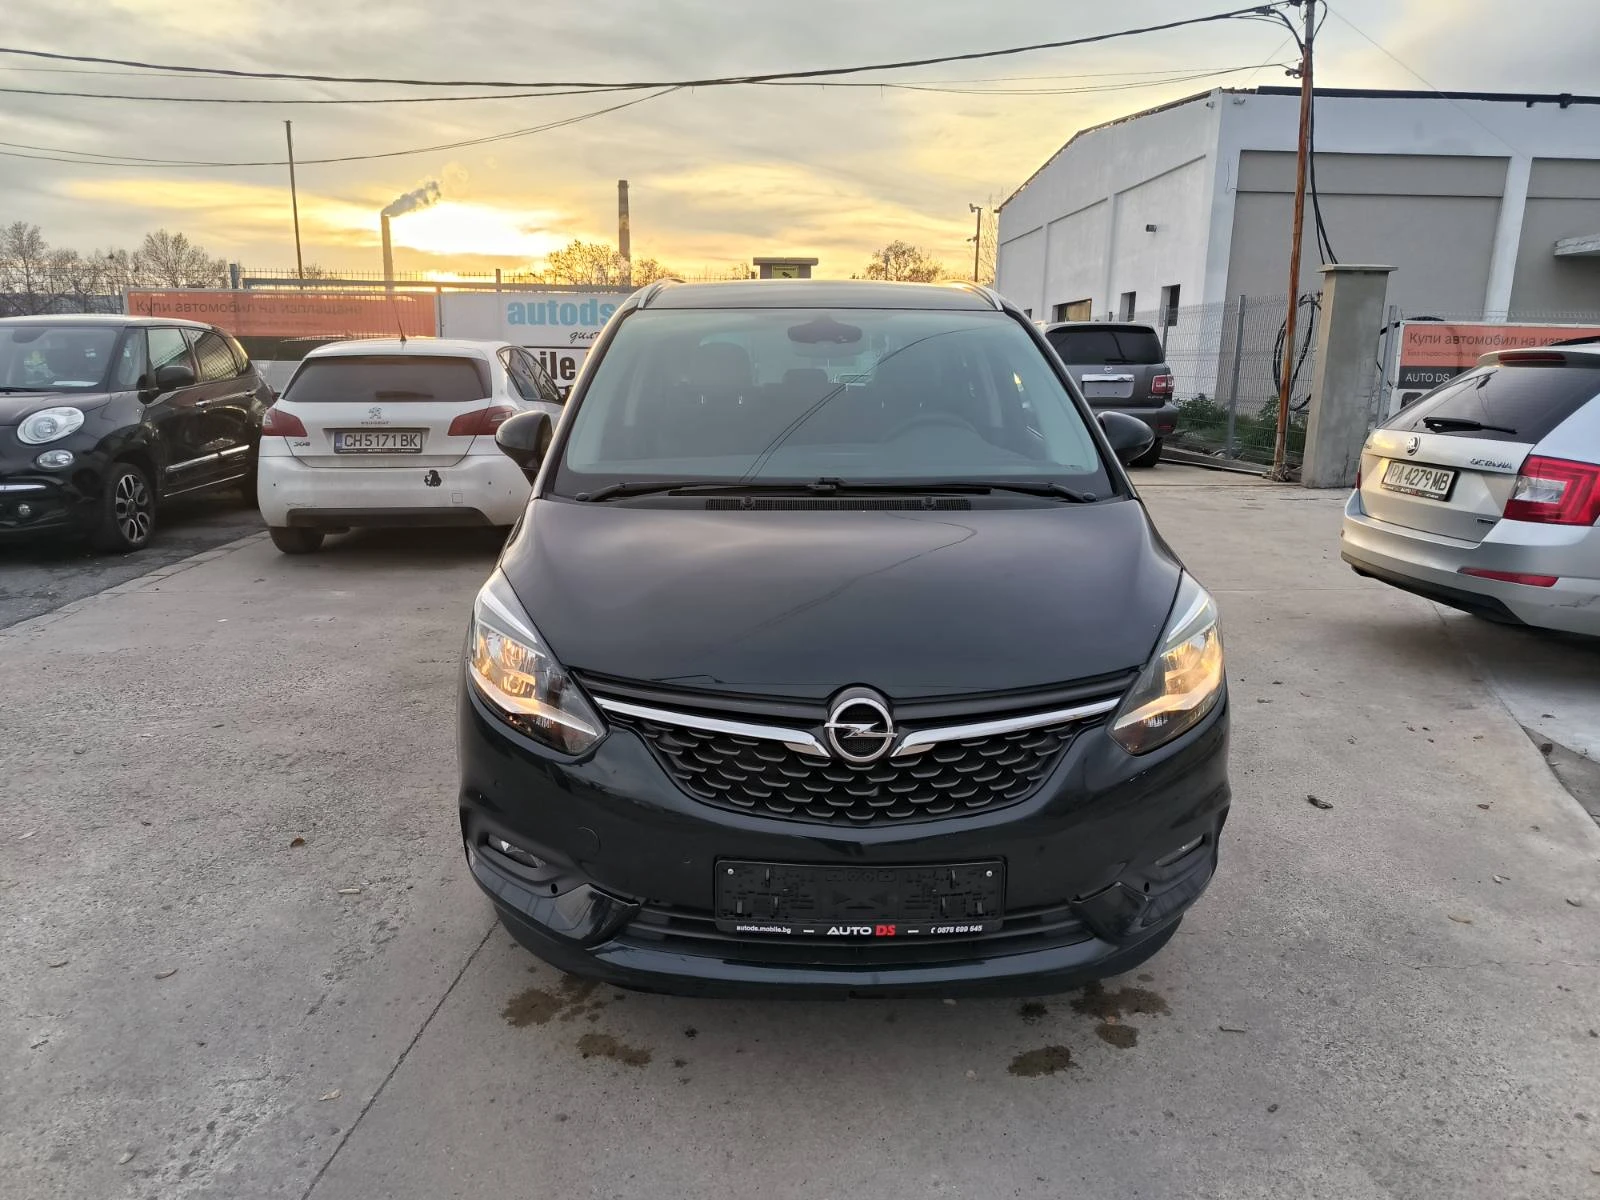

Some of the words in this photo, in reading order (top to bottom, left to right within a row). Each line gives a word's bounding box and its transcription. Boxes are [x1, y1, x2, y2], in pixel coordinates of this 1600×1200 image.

[136, 300, 171, 316] Купи
[175, 301, 254, 313] автомобил
[507, 298, 616, 326] autods
[1409, 333, 1441, 345] Купи
[1444, 334, 1517, 346] автомобил
[1520, 337, 1536, 347] на
[1405, 373, 1433, 383] AUTO
[1435, 373, 1450, 383] DS
[827, 926, 872, 935] AUTO
[875, 925, 896, 936] DS
